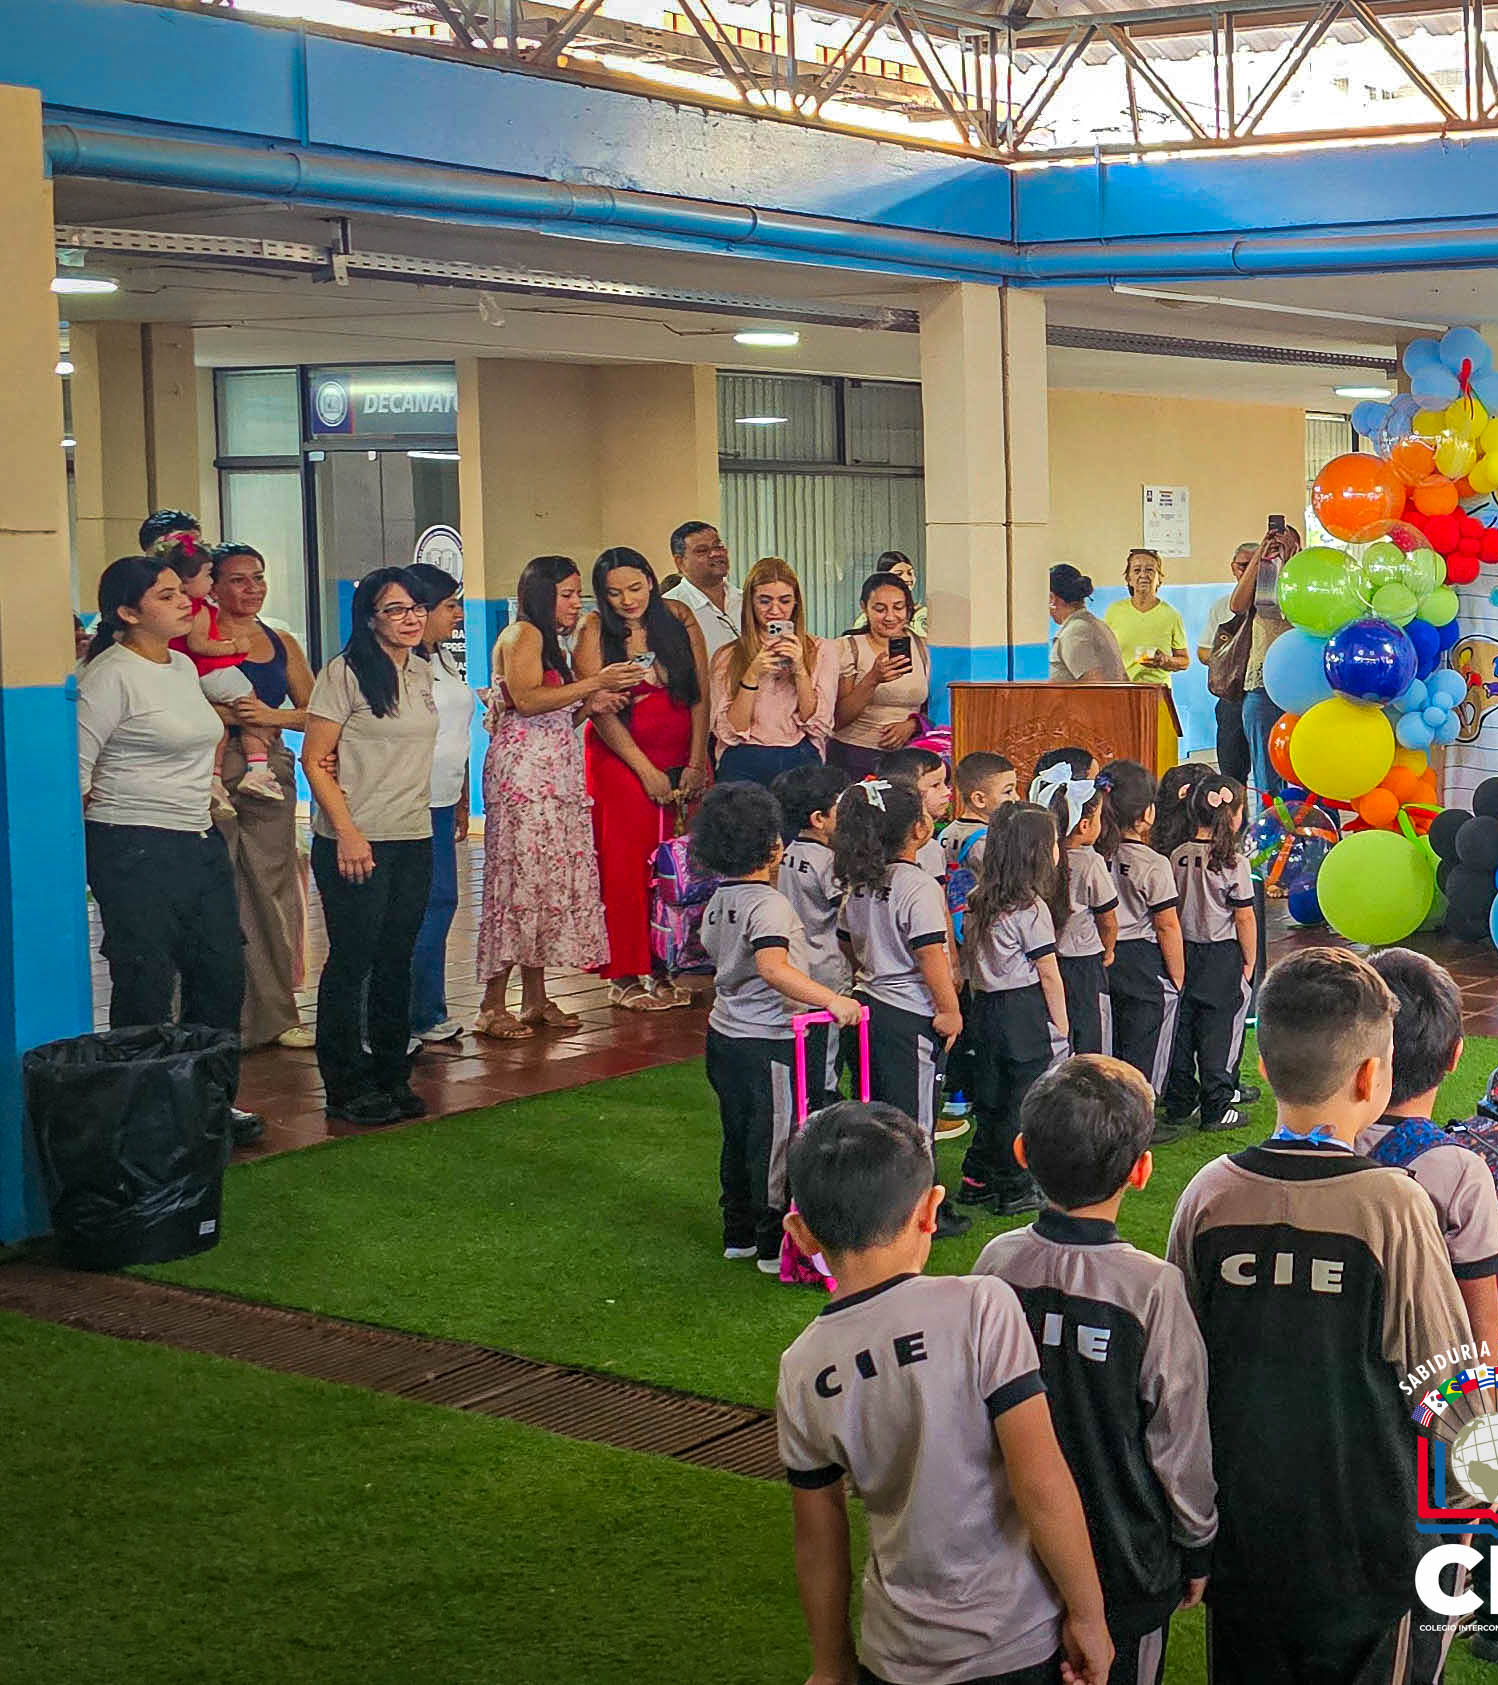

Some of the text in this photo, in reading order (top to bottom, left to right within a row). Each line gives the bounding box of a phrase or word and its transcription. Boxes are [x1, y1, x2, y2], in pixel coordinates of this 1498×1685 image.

[1220, 1252, 1345, 1294] CIE
[1042, 1312, 1111, 1362] IE
[815, 1330, 929, 1399] CIE
